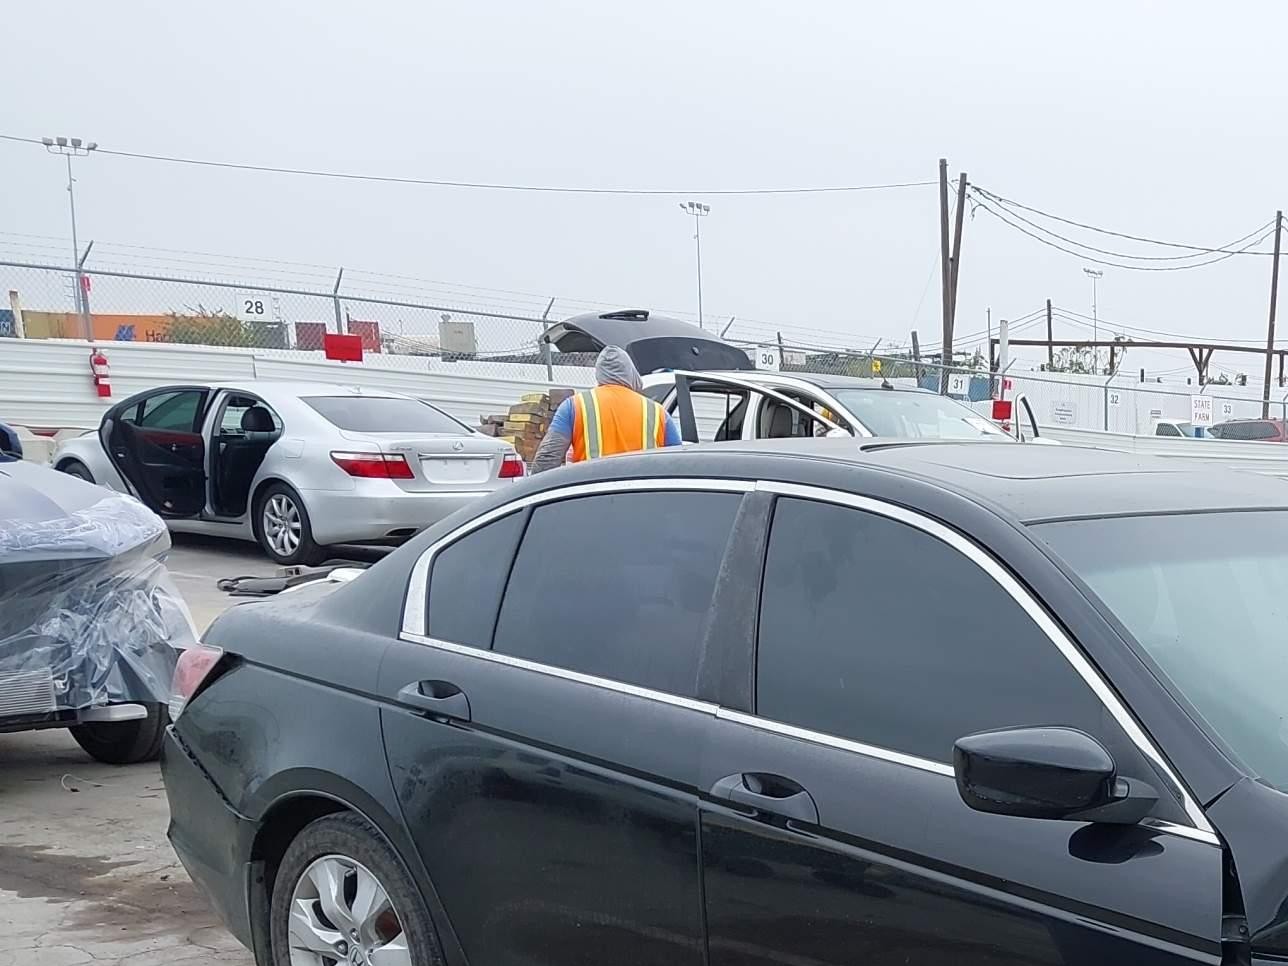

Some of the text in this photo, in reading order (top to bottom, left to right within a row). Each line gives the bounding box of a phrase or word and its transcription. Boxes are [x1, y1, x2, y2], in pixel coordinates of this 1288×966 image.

[244, 300, 264, 315] 28
[761, 353, 774, 365] 30
[953, 378, 963, 390] 31
[1110, 394, 1119, 404] 32
[1193, 399, 1211, 409] STATE
[1223, 404, 1232, 414] 33
[1194, 412, 1210, 421] FARM
